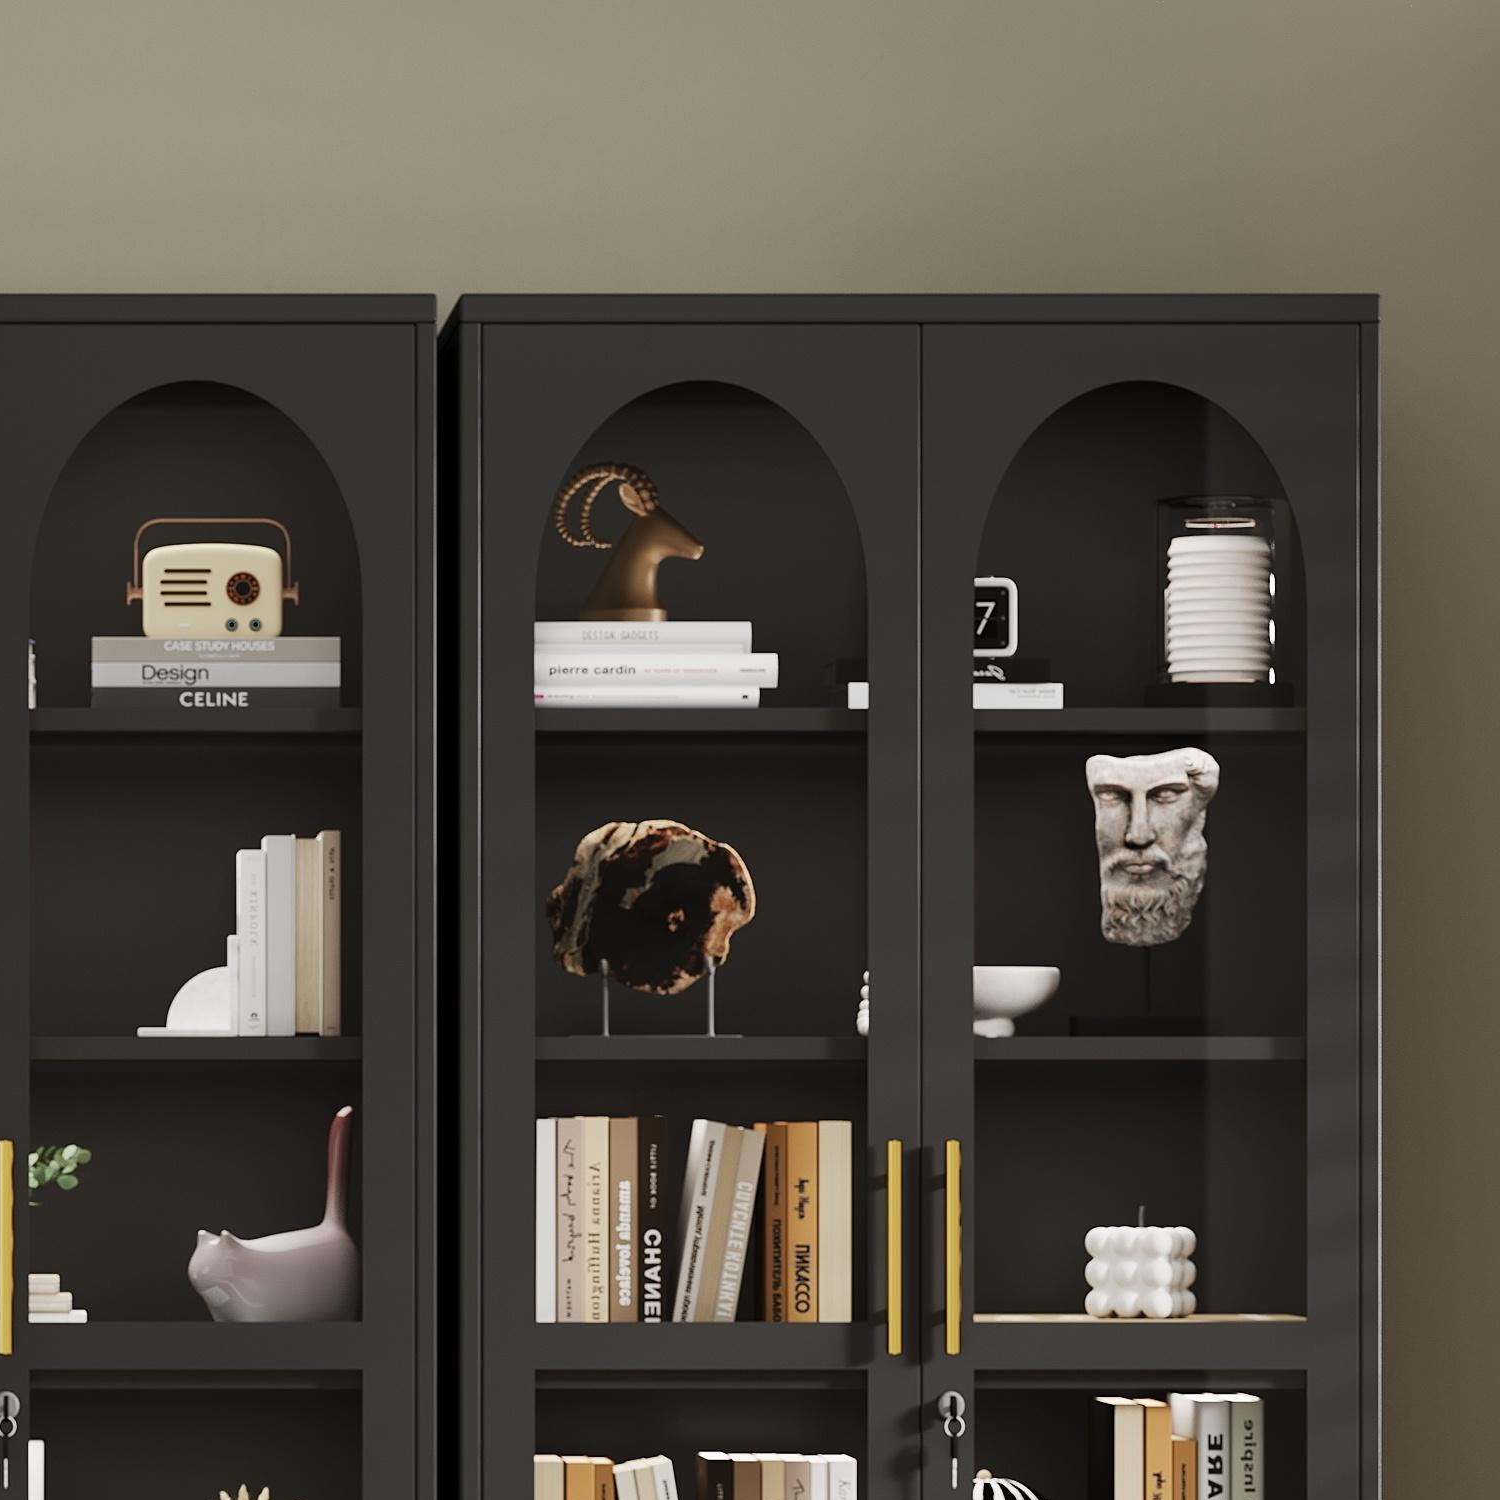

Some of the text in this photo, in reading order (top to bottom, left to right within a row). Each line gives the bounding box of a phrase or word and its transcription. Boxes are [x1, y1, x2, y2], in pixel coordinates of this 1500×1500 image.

[975, 601, 996, 635] 7
[582, 630, 660, 641] DESIGN GADGETS
[164, 640, 276, 652] CASE STUDY HOUSES
[141, 664, 210, 686] Design
[549, 665, 589, 677] pierre
[594, 665, 637, 675] cardin
[179, 691, 250, 708] CELINE
[795, 1245, 811, 1314] ПИКАССО
